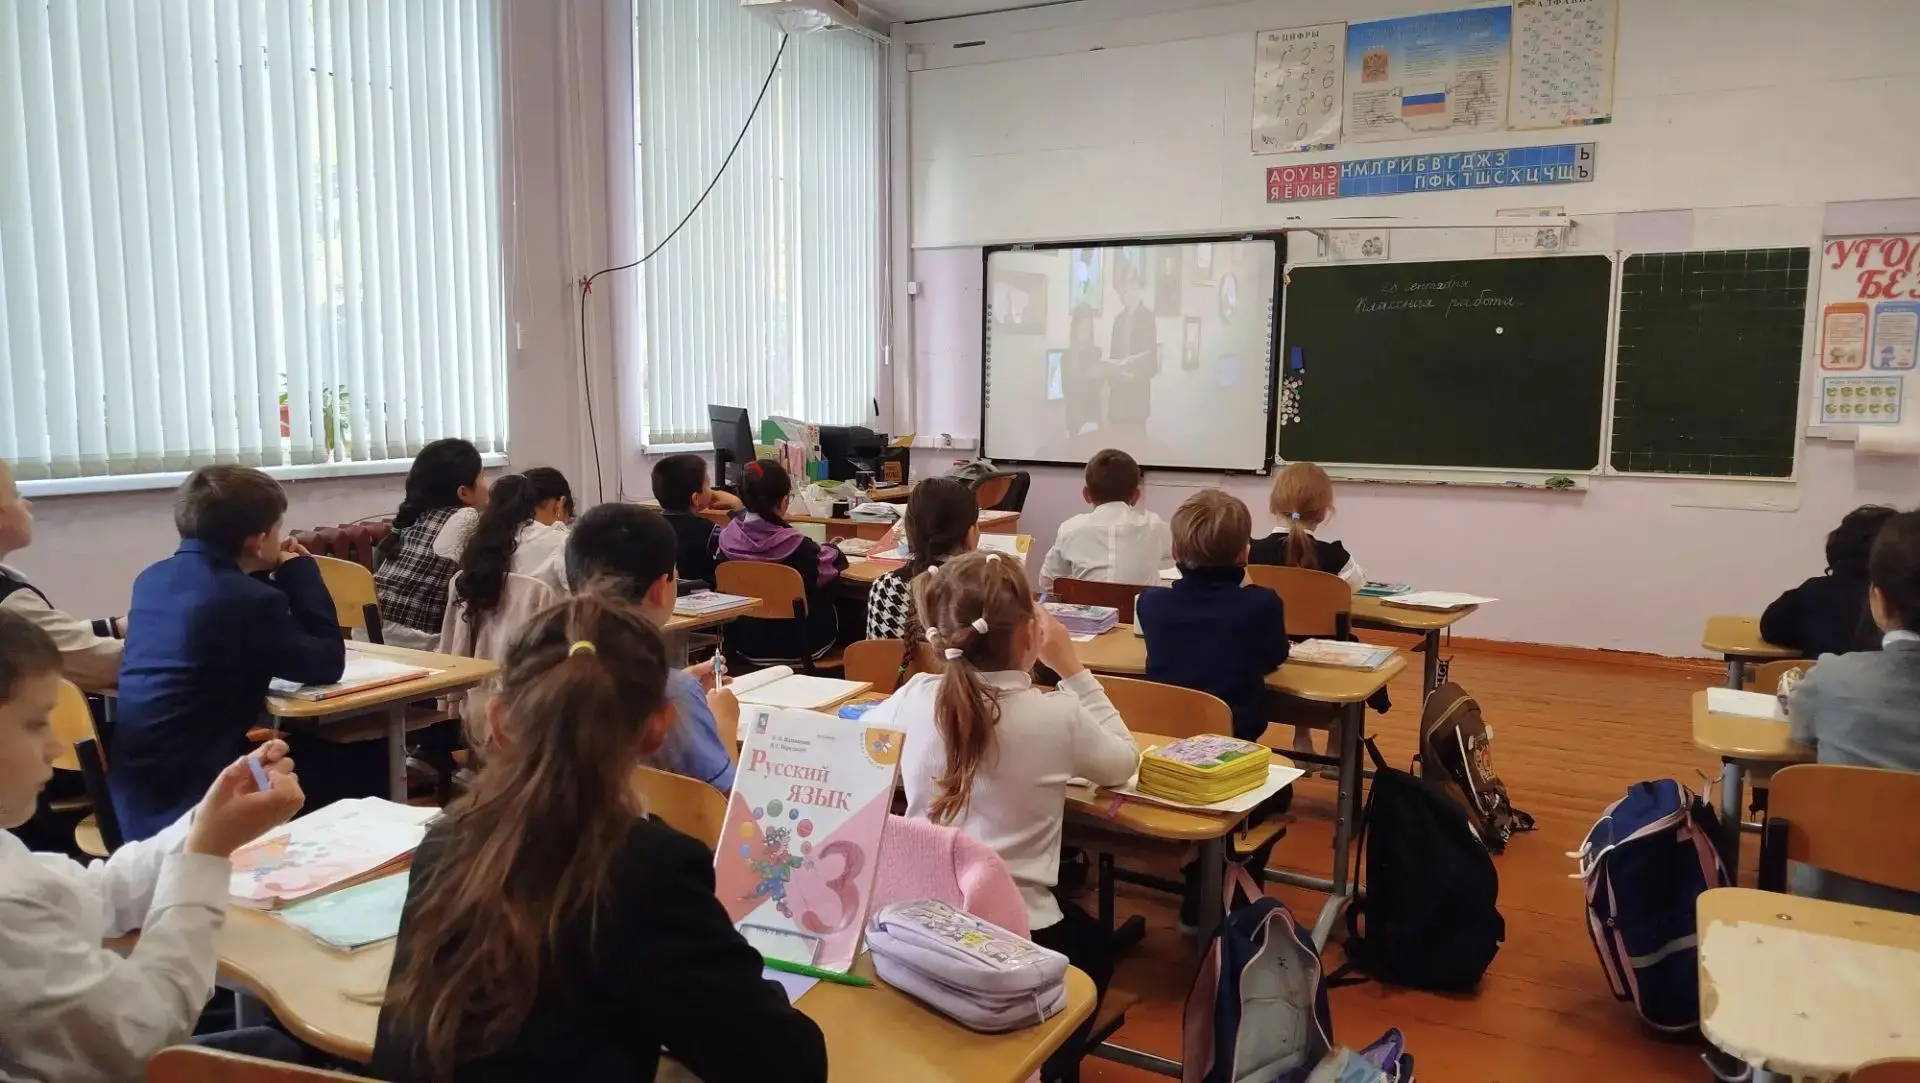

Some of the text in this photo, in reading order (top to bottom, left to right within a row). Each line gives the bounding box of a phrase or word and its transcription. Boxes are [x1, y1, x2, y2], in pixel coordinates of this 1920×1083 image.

[1538, 0, 1593, 8] АЛФАВ
[1282, 31, 1319, 41] ЦИФРЫ
[1301, 47, 1310, 66] 2
[1323, 44, 1335, 64] 3
[1299, 67, 1309, 91] 5
[1323, 70, 1335, 89] 6
[1275, 99, 1285, 118] 7
[1297, 97, 1307, 116] 8
[1321, 95, 1334, 115] 9
[1296, 122, 1308, 141] 0
[746, 749, 830, 782] Русский
[802, 839, 866, 934] 3
